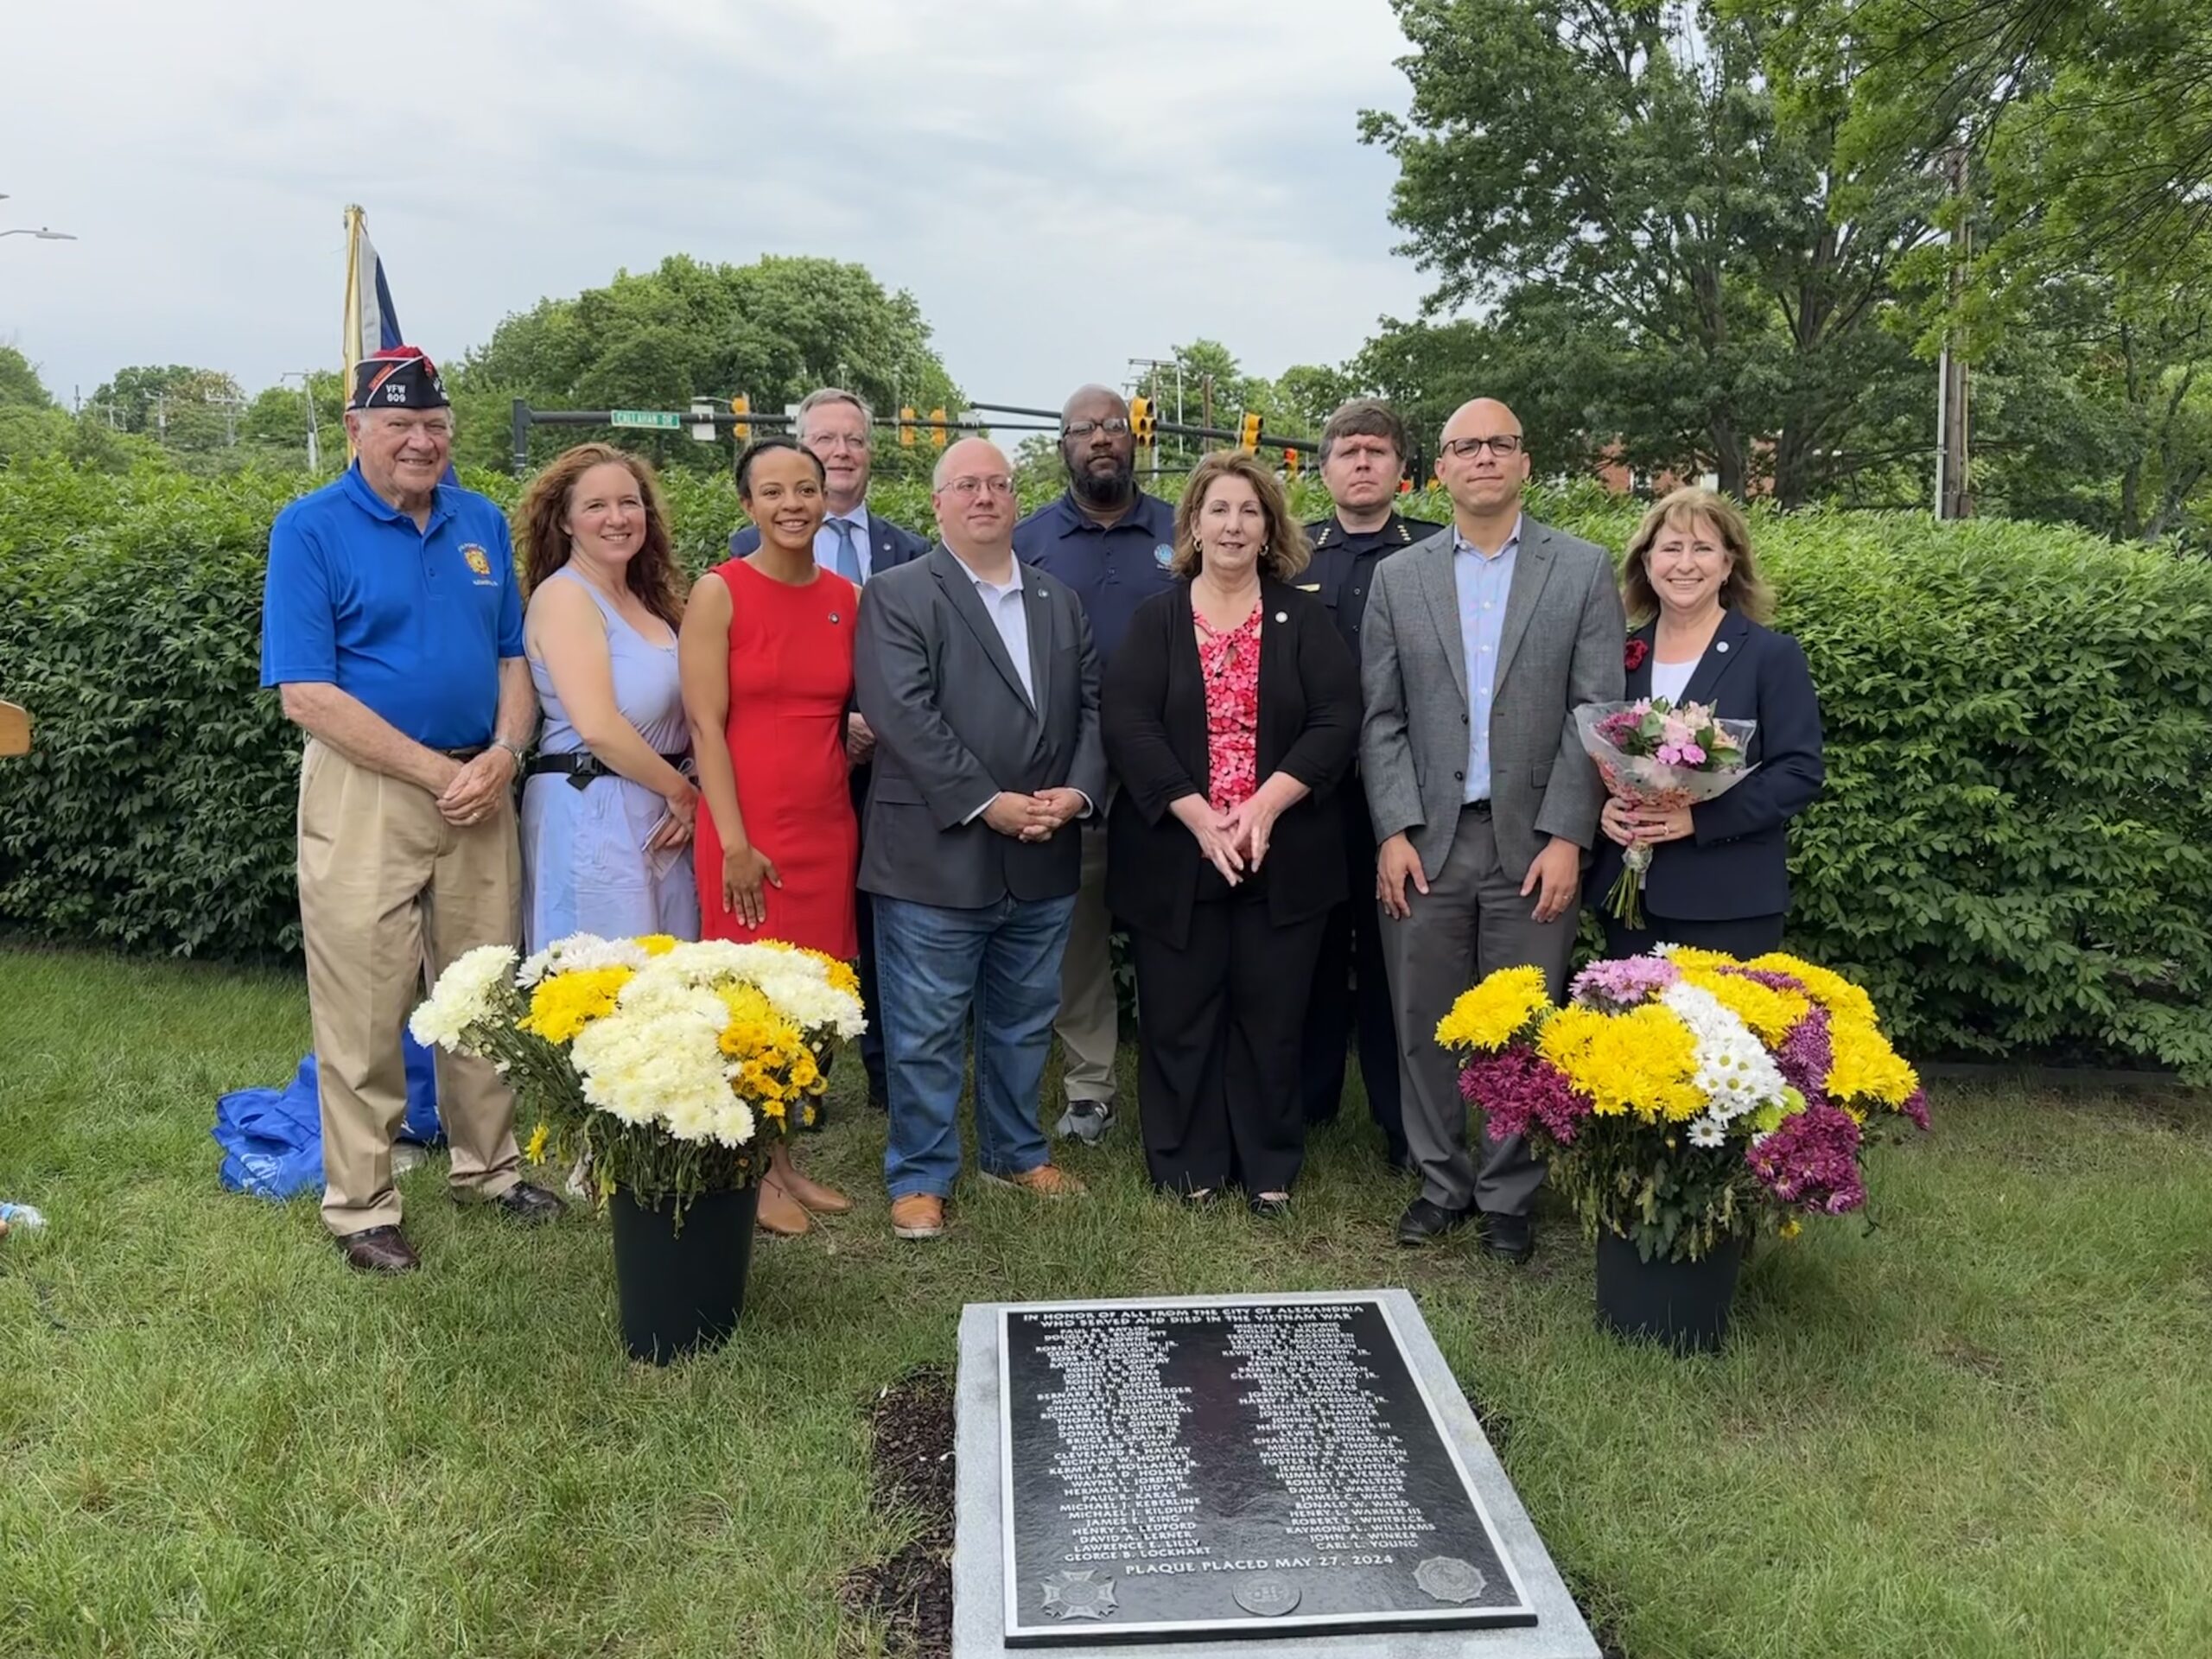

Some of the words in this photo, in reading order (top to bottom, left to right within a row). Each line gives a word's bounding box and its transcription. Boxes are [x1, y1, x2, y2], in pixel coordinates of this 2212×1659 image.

[385, 385, 406, 394] VFW
[1065, 1487, 1118, 1496] HERMAN
[1060, 1502, 1117, 1511] MICHAEL
[1135, 1497, 1201, 1507] KEBERLINE
[1069, 1510, 1127, 1518] MICHAEL
[1145, 1506, 1195, 1515] KILDUFF
[1359, 1515, 1425, 1523] WHITBECK
[1138, 1522, 1197, 1531] LEDFORD
[1080, 1535, 1120, 1543] DAVID
[1143, 1531, 1192, 1540] LERNER
[1074, 1542, 1143, 1552] LAWRENCE
[1065, 1552, 1117, 1561] GEORGE
[1141, 1547, 1211, 1557] LOCKHART
[1125, 1563, 1196, 1576] PLAQUE
[1202, 1560, 1269, 1572] PLACED
[1274, 1558, 1314, 1568] MAY
[1351, 1554, 1395, 1565] 2024
